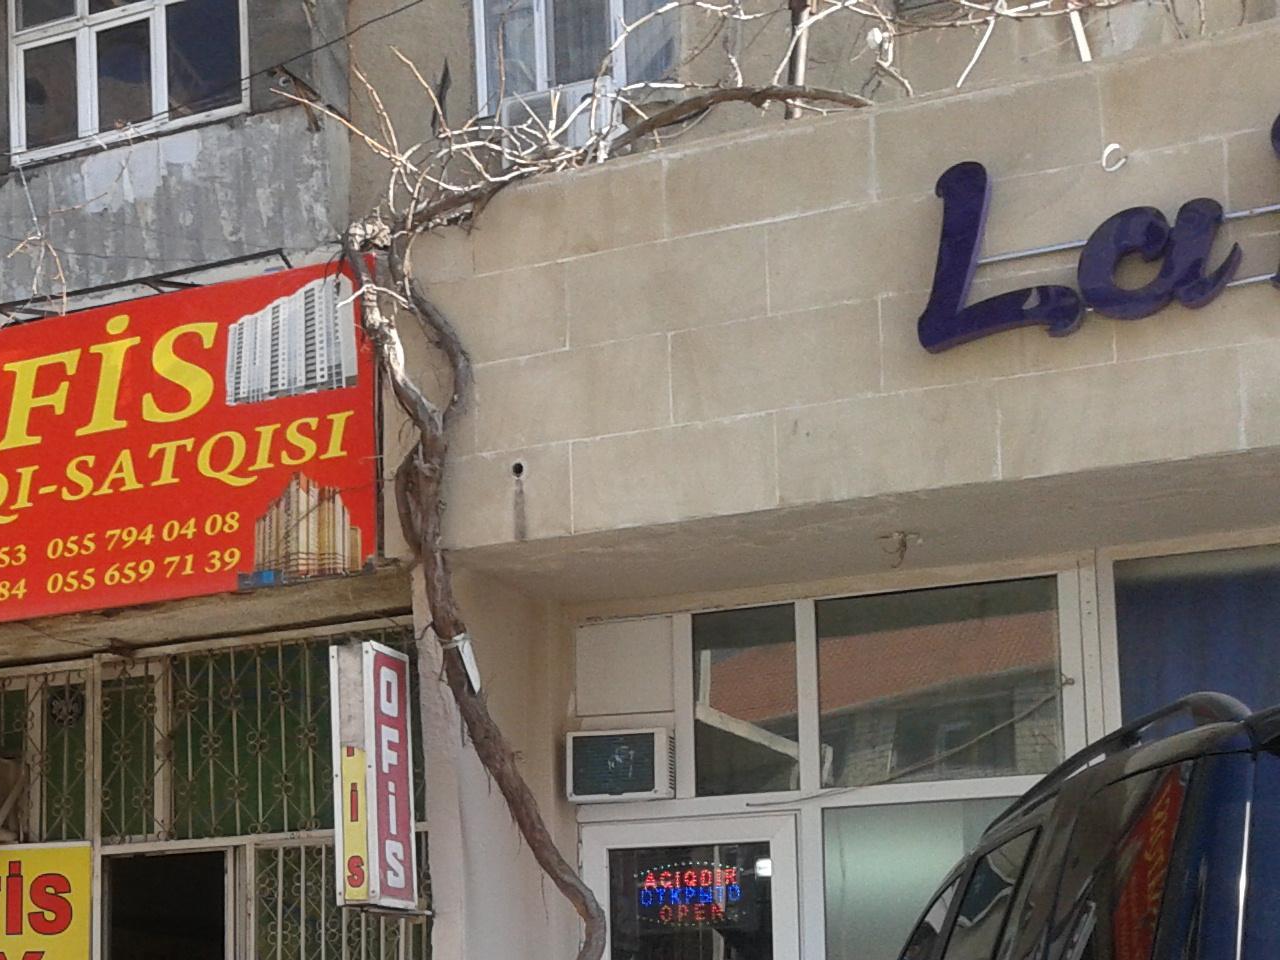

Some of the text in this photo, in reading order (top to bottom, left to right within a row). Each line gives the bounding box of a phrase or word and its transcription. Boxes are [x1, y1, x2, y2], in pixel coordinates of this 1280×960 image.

[917, 161, 1242, 354] La
[47, 511, 240, 560] 055 794 04 08
[46, 547, 241, 594] 055 659 71 39
